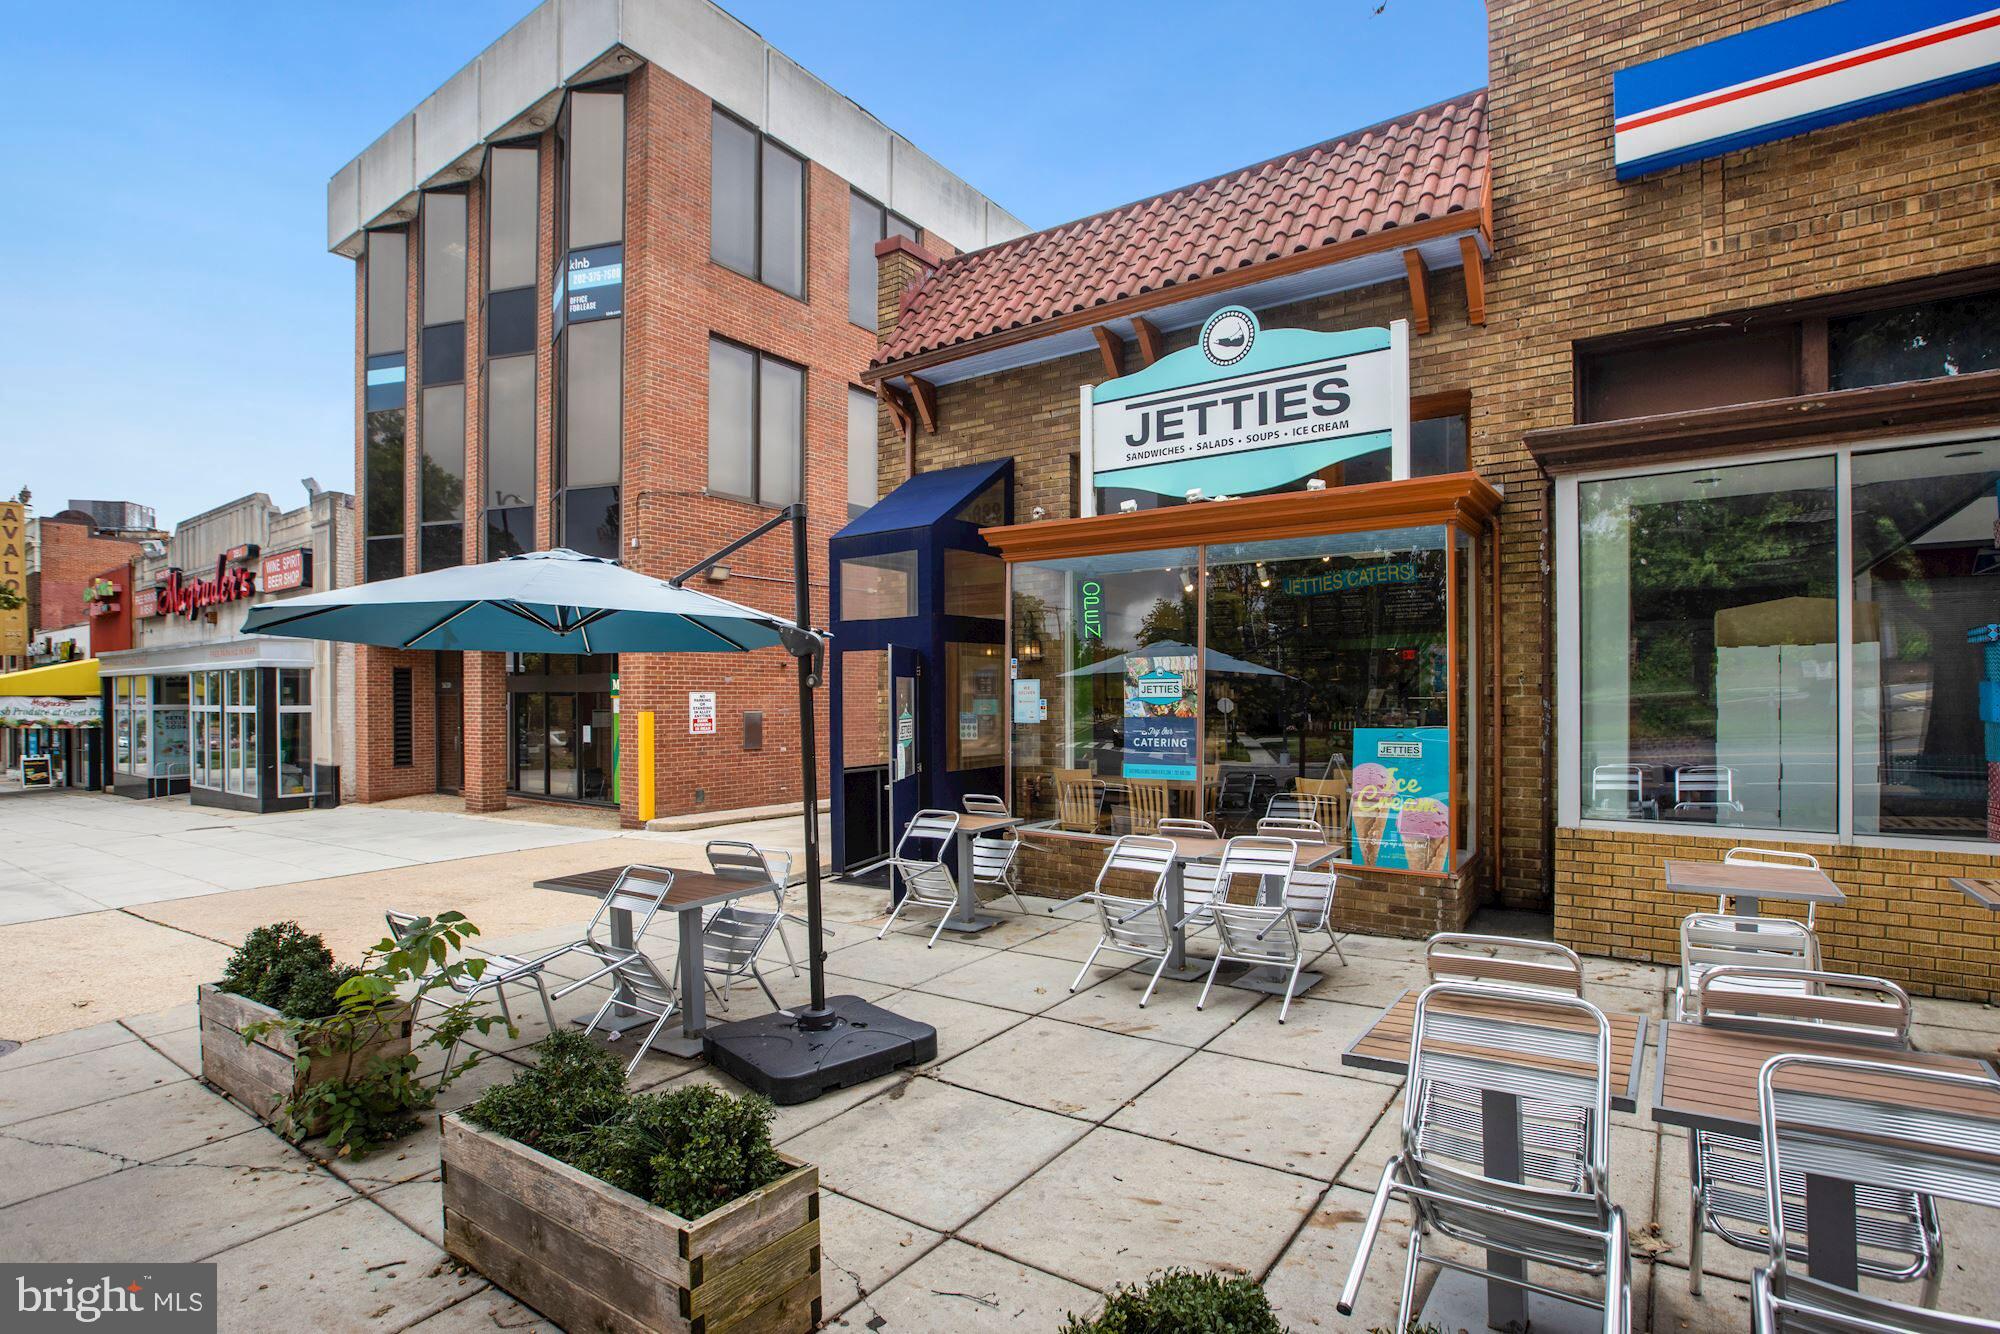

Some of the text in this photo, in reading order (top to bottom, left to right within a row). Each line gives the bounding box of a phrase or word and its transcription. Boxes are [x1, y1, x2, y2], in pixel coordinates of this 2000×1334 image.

[569, 257, 590, 270] klnb
[569, 295, 588, 304] OFFICE
[1125, 377, 1351, 447] JETTIES
[1126, 419, 1350, 462] SANDWICHES SALADS SOUPS ICE CREAM
[2, 508, 20, 594] AVALO
[265, 558, 281, 574] WINE
[267, 569, 300, 589] BEER SHOP
[1284, 562, 1416, 595] JETTIES CATERS!
[1083, 582, 1101, 639] OPEN
[1141, 685, 1180, 695] JETTIES
[1133, 737, 1188, 748] CATERING
[1380, 746, 1420, 754] JETTIES
[1382, 767, 1422, 793] Ice
[1357, 784, 1440, 813] Cream
